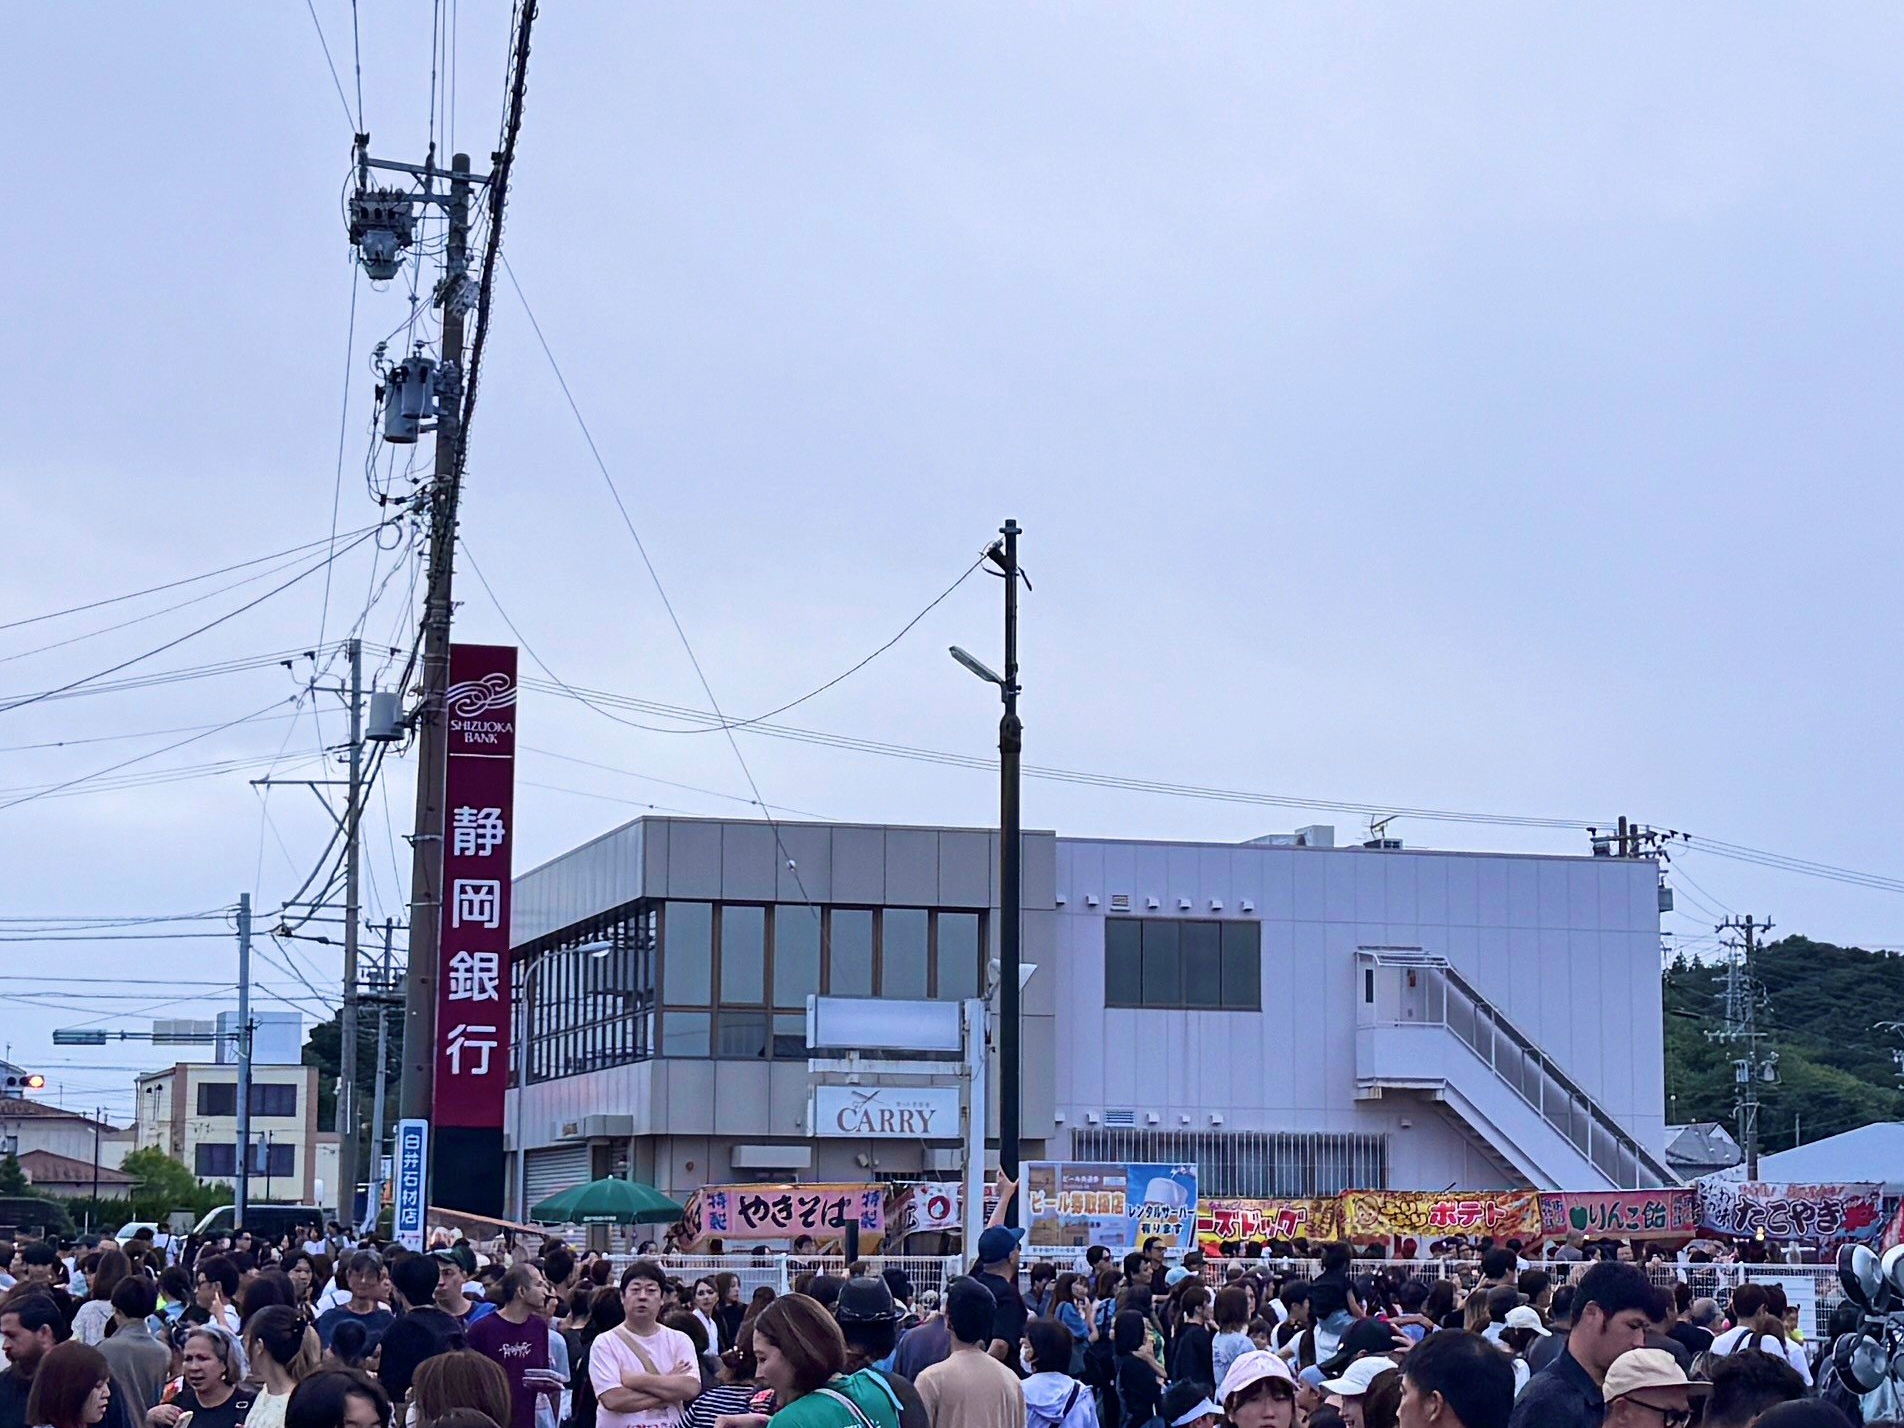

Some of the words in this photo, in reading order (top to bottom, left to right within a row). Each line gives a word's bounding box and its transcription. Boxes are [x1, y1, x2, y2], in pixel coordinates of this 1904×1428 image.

[450, 720, 513, 733] SHIZUOKA
[464, 732, 498, 744] BANK
[446, 805, 505, 1075] 静岡銀行
[836, 1106, 937, 1134] CARRY
[737, 1194, 859, 1230] やきそば
[1198, 1208, 1307, 1240] ーズドッグ
[1734, 1195, 1842, 1235] たこやき
